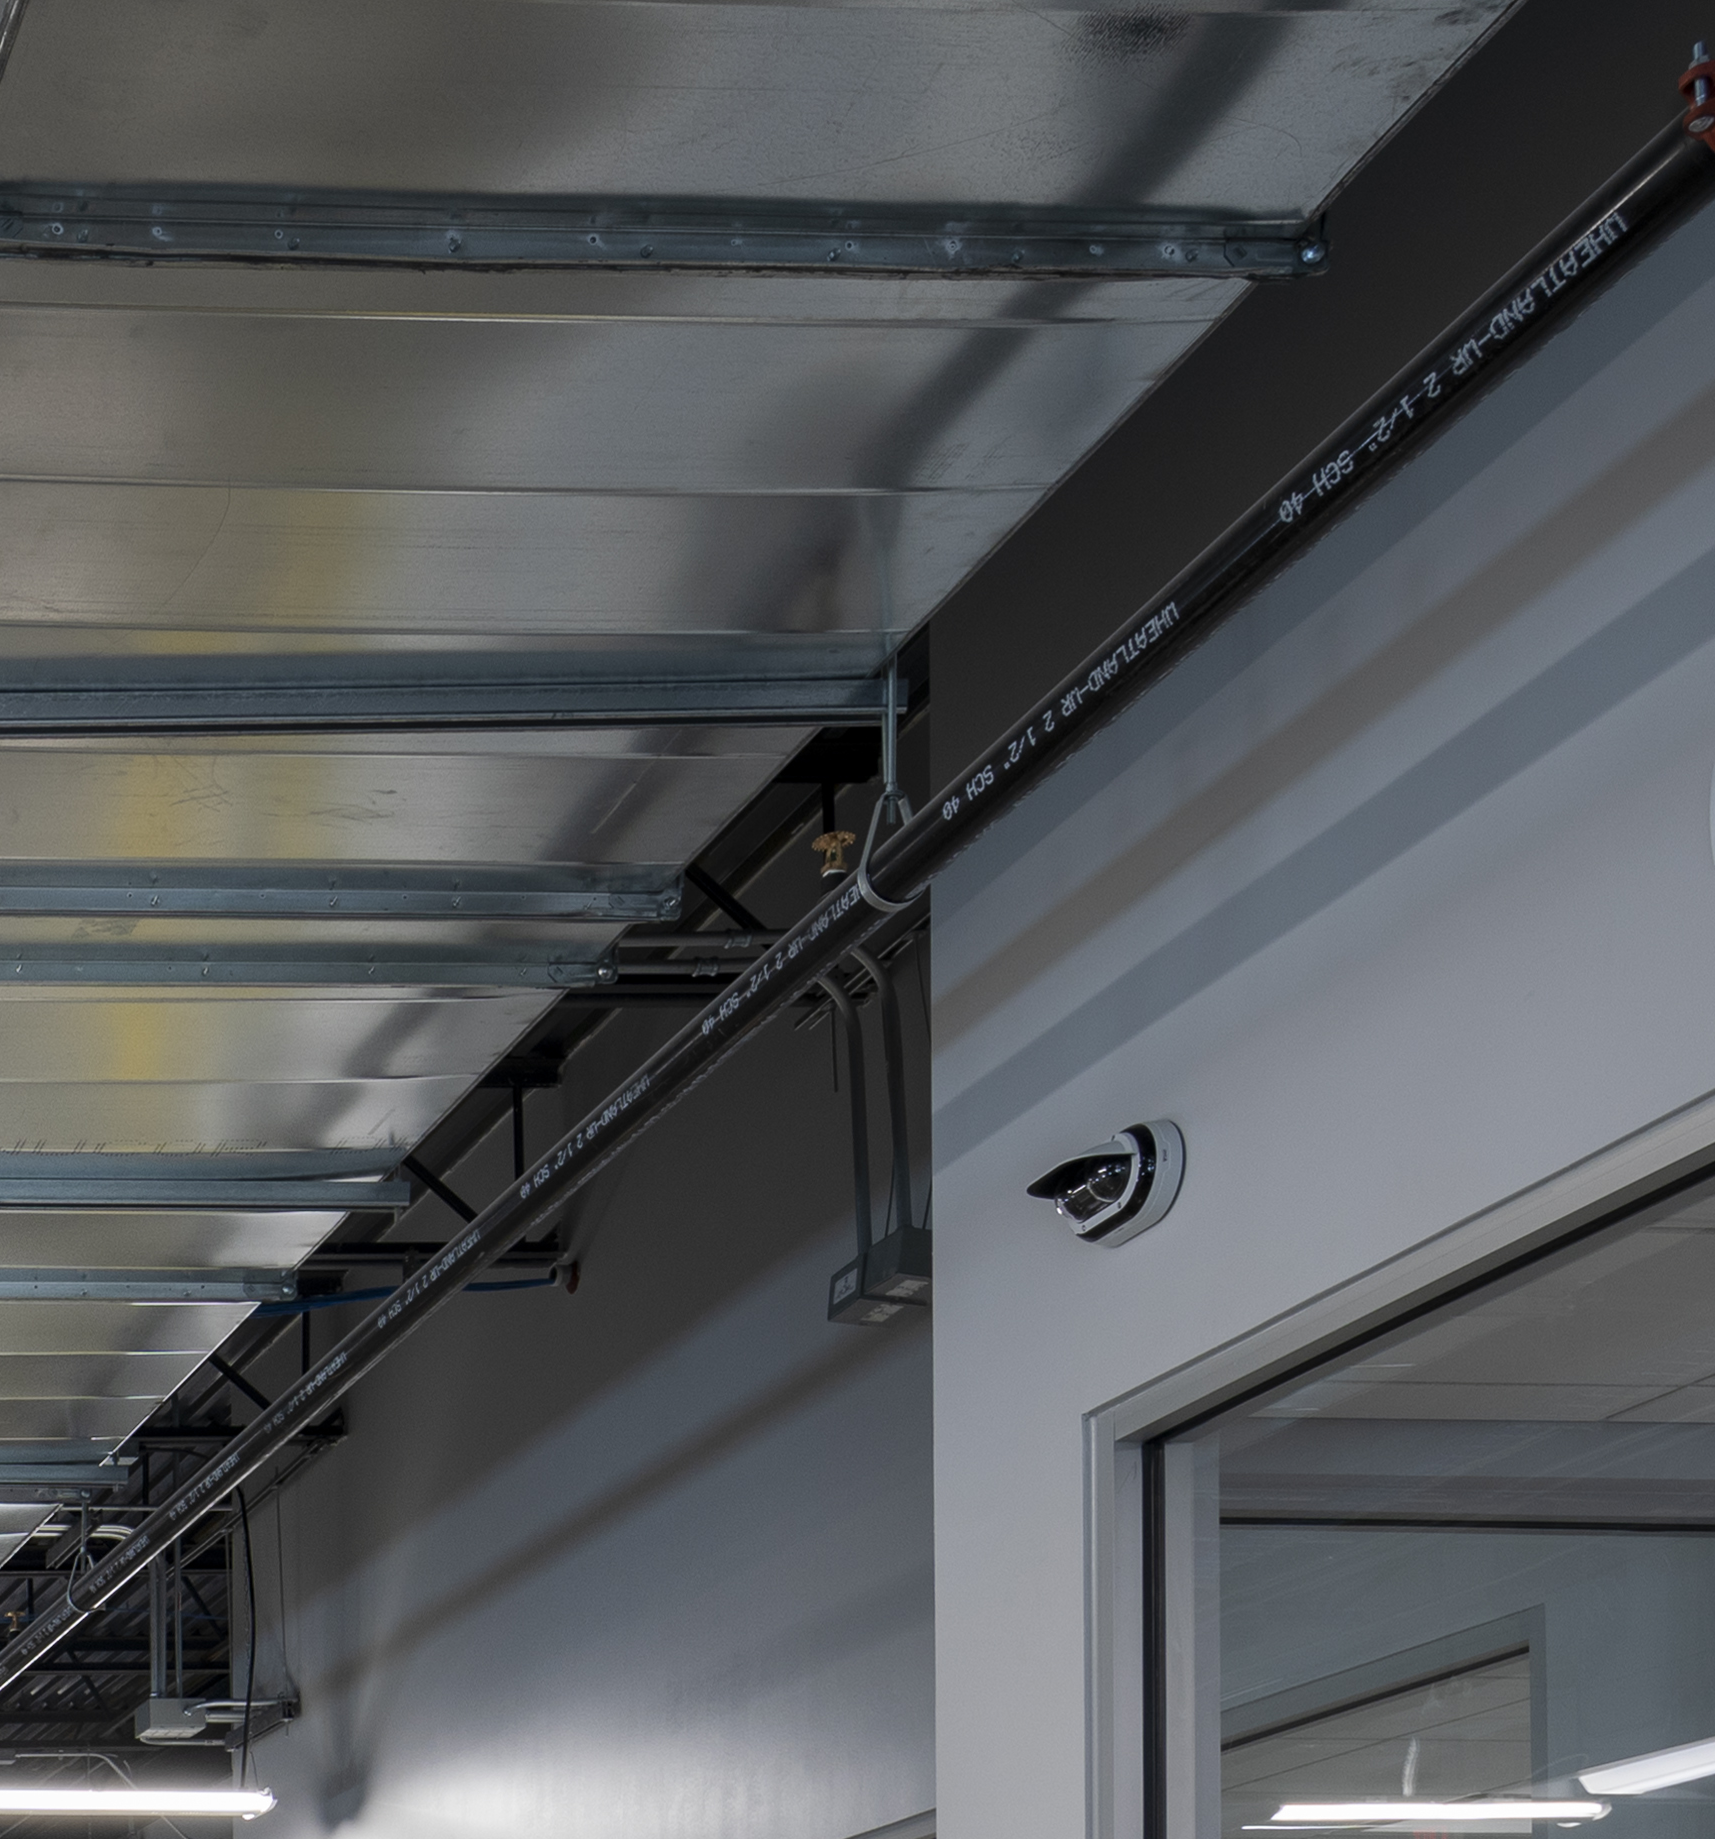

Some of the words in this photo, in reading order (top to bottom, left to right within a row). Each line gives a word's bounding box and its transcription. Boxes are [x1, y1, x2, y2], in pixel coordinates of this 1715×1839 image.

[1450, 211, 1628, 375] WHEATLAND-WR
[1422, 371, 1441, 398] 2
[1361, 394, 1414, 452] 1/2"
[1311, 449, 1354, 496] SCH
[1278, 491, 1307, 522] 40
[1060, 600, 1179, 717] WHEATLAND-WR
[1041, 709, 1055, 732] 2
[1003, 725, 1036, 770] 1/2"
[965, 763, 994, 800] SCH
[941, 795, 960, 820] 40
[786, 883, 863, 959] EATLAND-WR
[774, 951, 786, 970] 2
[743, 963, 773, 998] 1/2"
[717, 991, 742, 1021] SCH
[700, 1016, 717, 1035] 40
[553, 1141, 573, 1170] 1/2"
[576, 1132, 583, 1149] 2
[533, 1163, 550, 1188] SCH
[421, 1274, 431, 1289] 2
